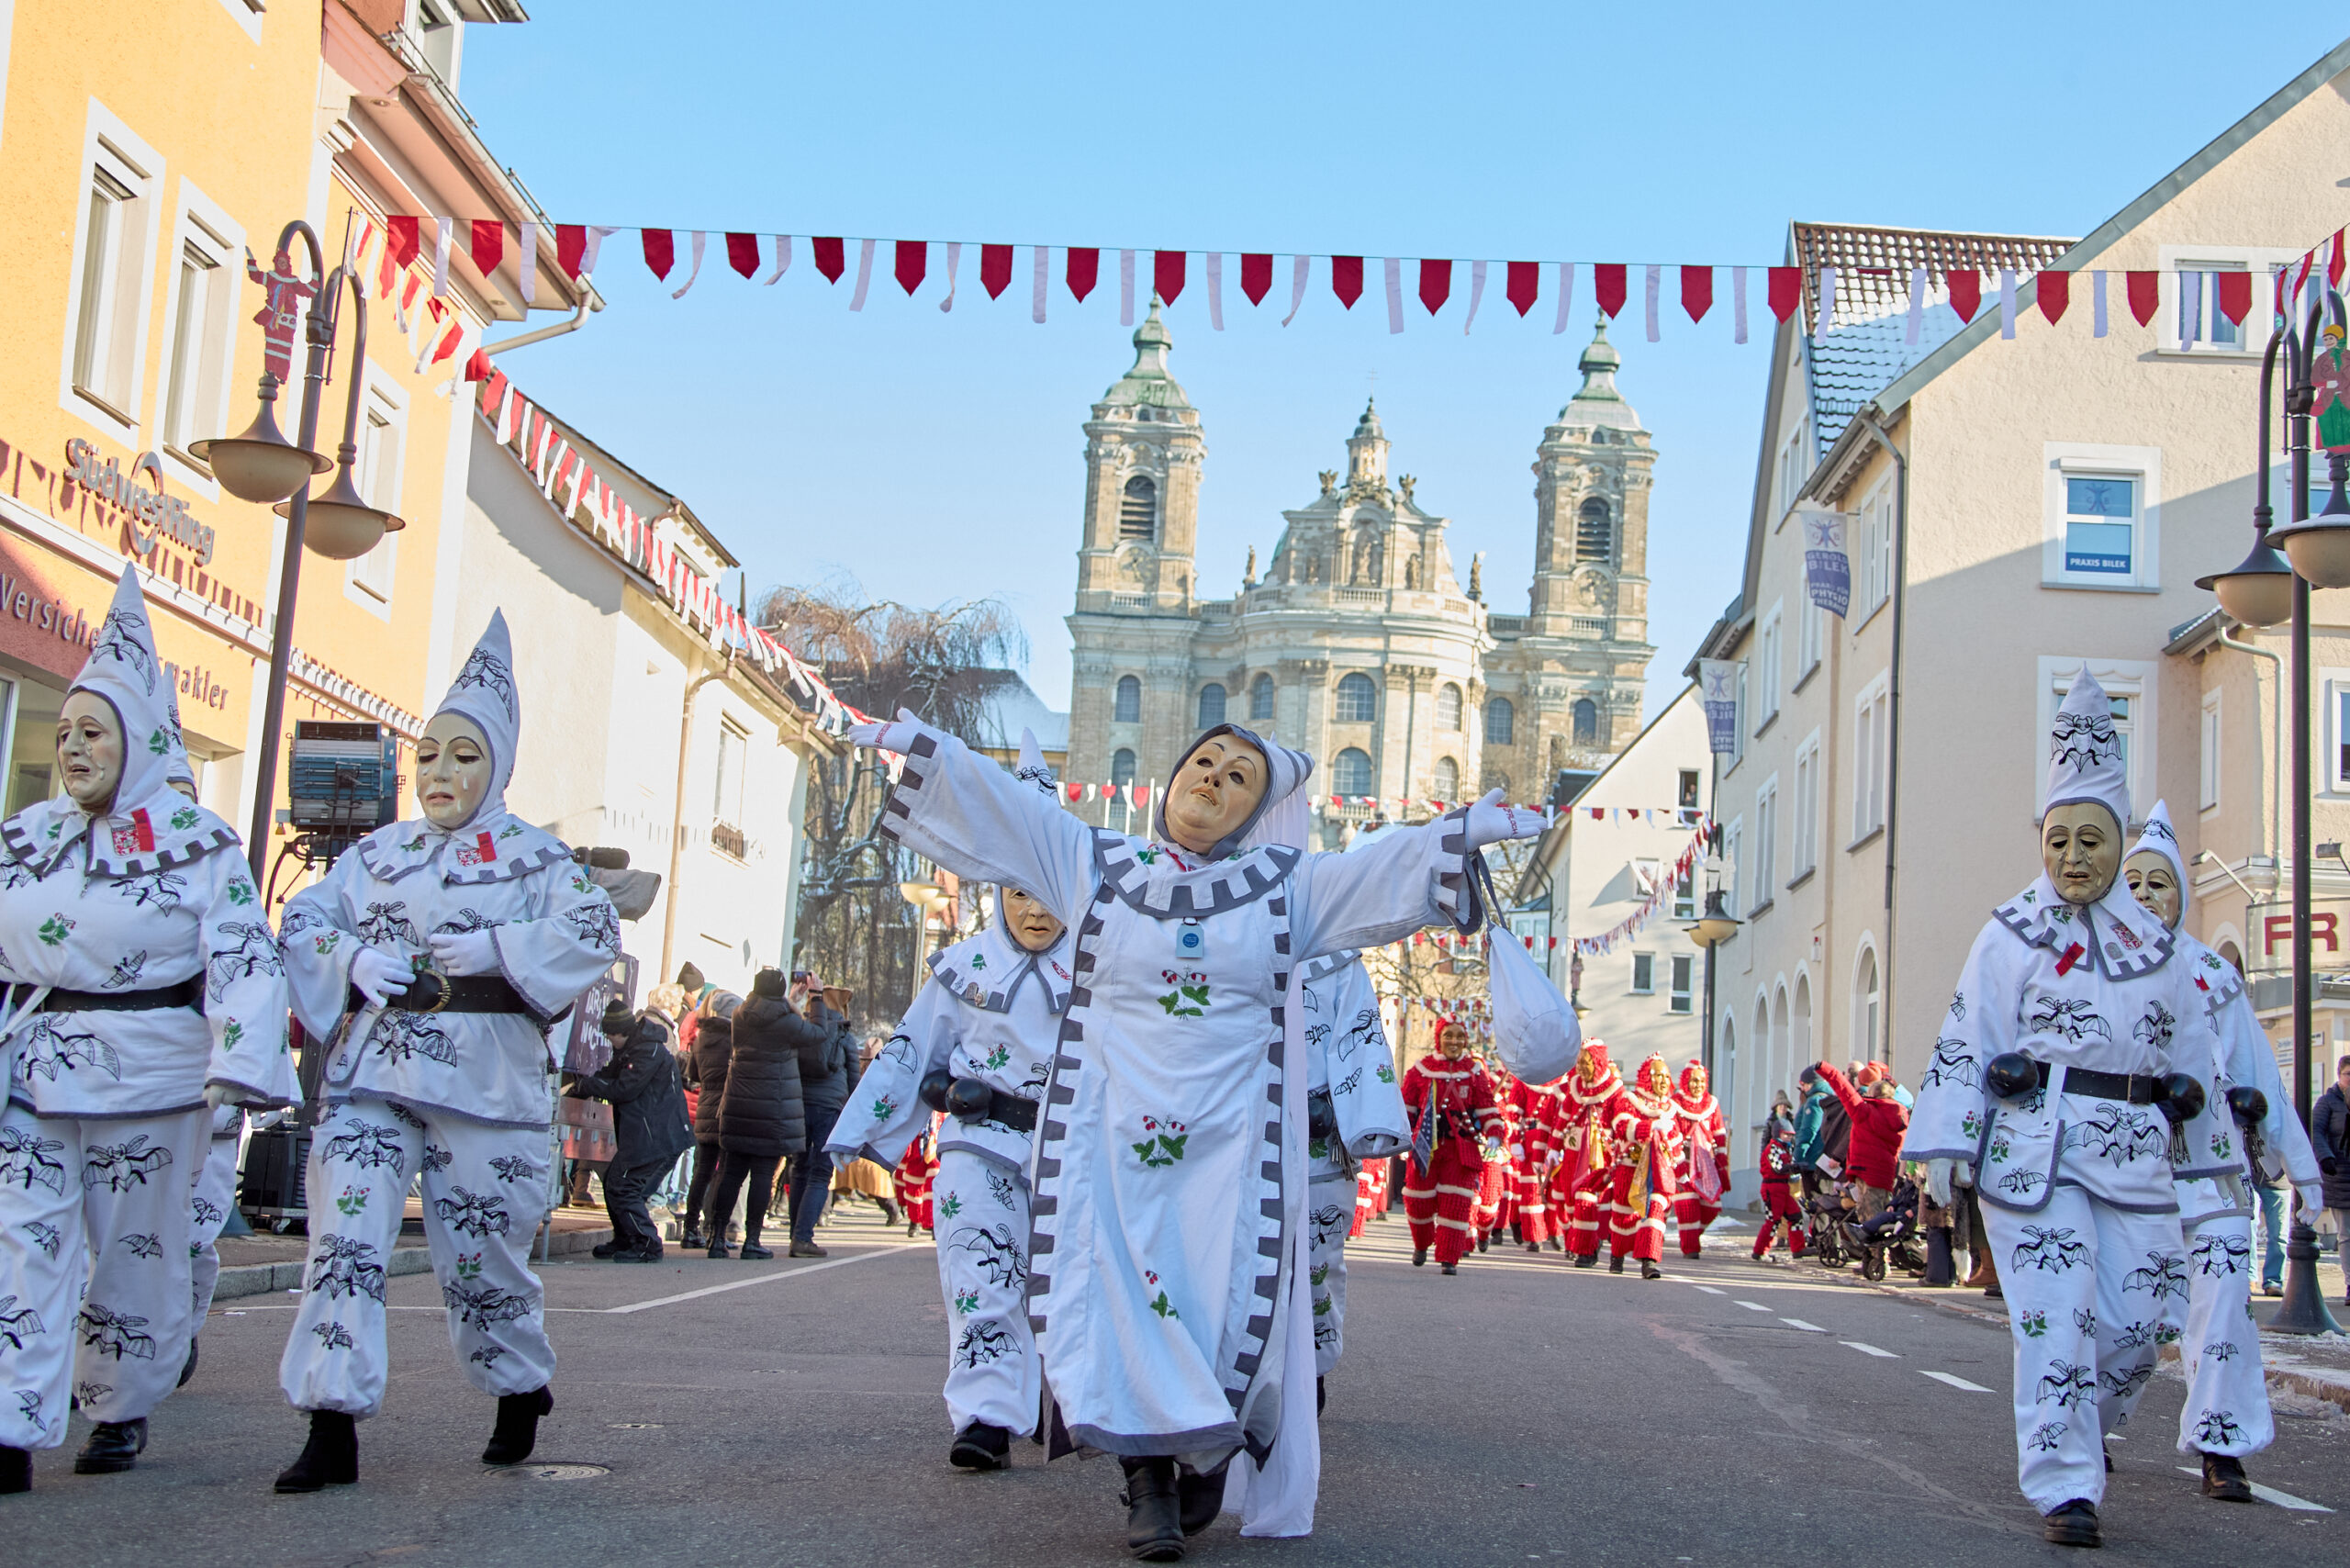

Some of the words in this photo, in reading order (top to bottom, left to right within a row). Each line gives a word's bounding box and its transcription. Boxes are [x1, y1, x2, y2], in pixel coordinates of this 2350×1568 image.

[64, 438, 215, 566] SüdwestRing
[2070, 557, 2100, 567] PRAXIS
[2102, 559, 2126, 568] BILEK
[2264, 913, 2350, 956] FR
